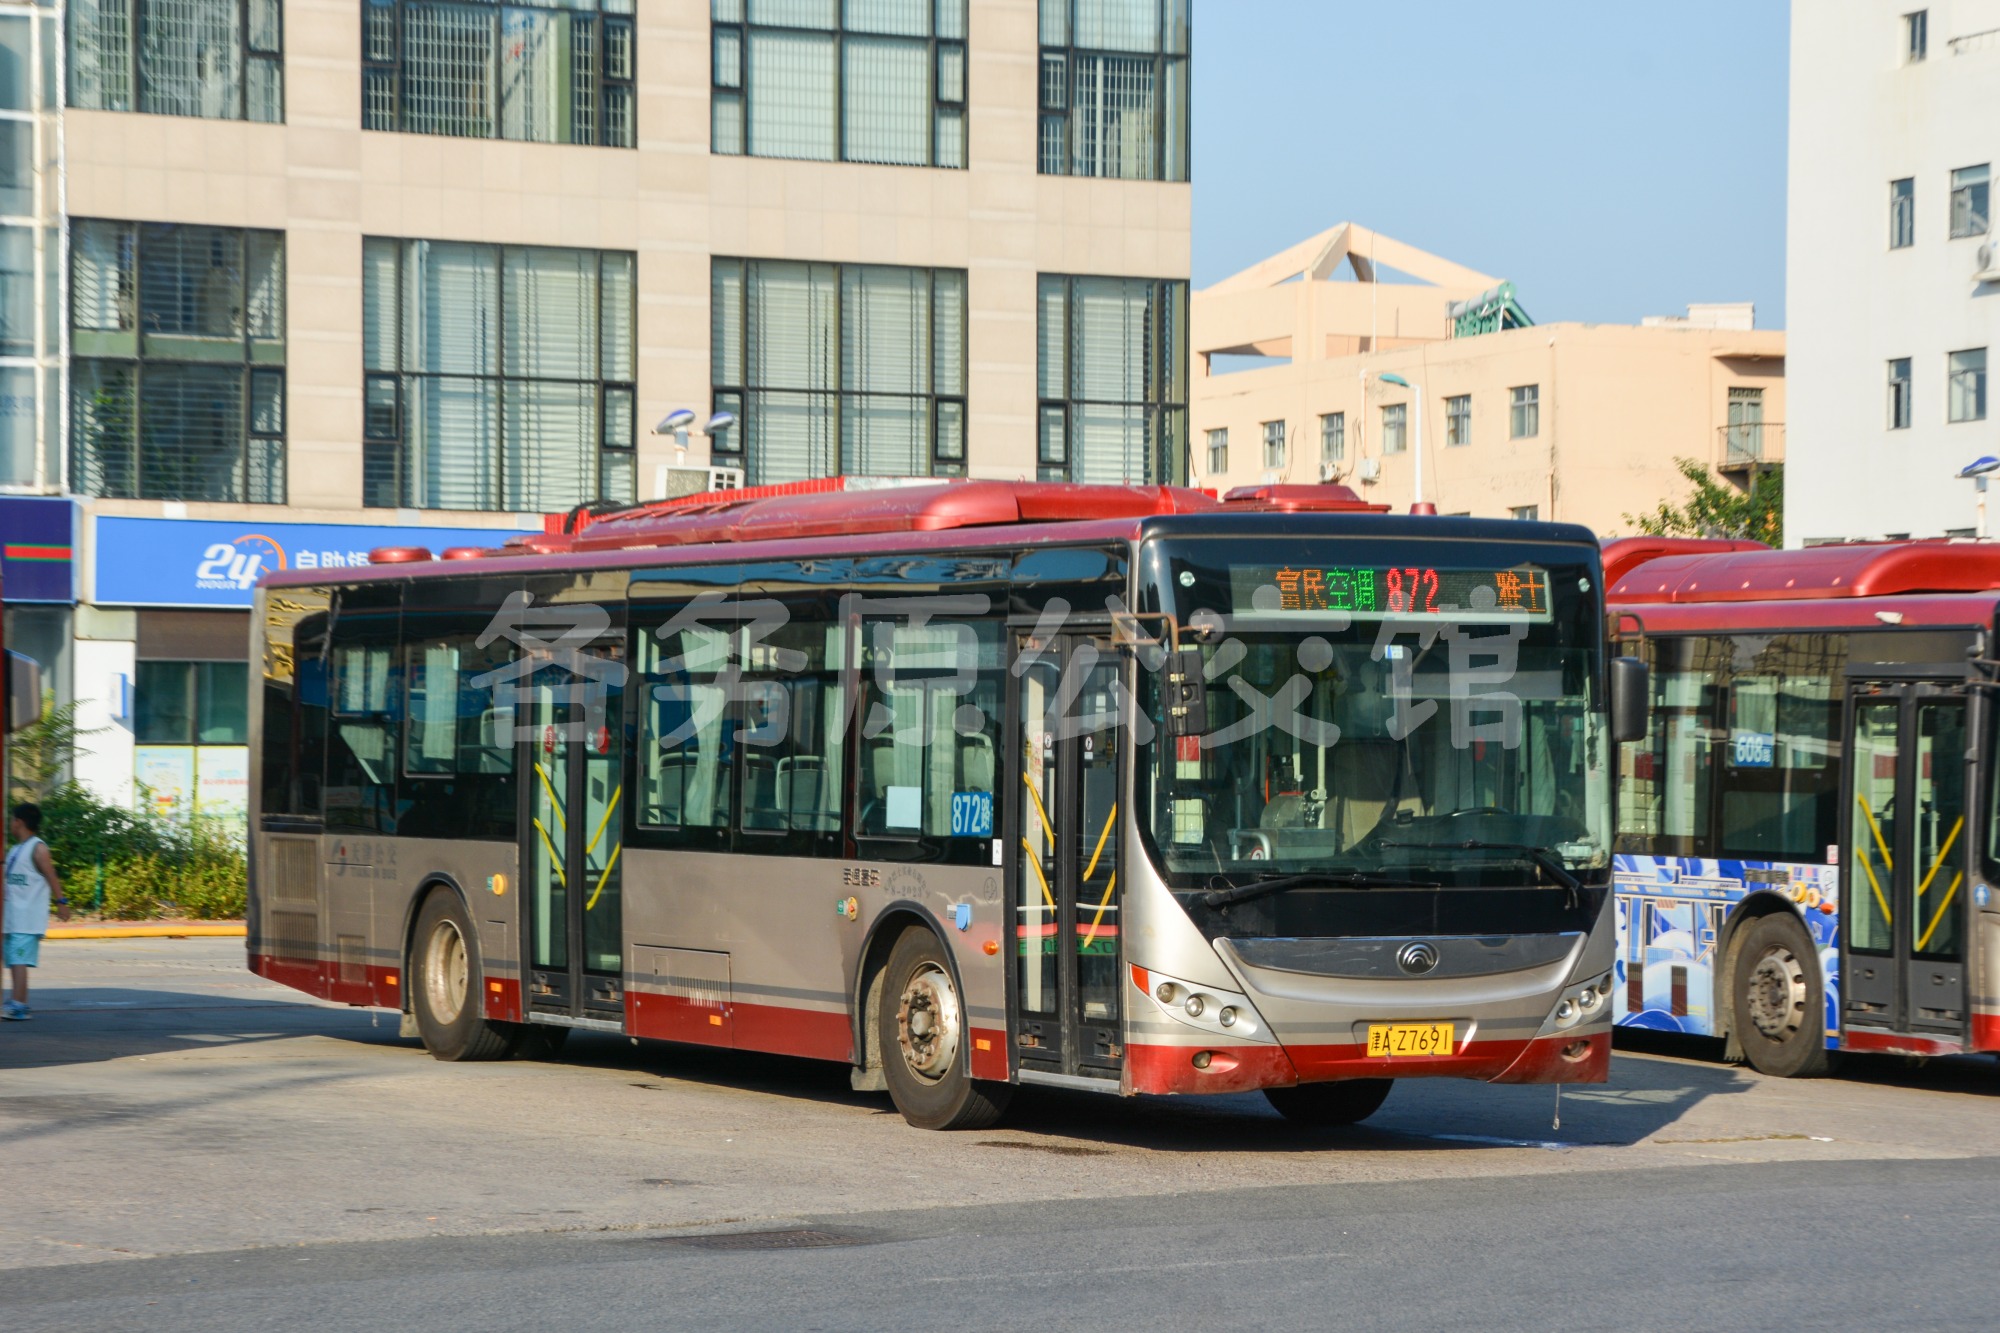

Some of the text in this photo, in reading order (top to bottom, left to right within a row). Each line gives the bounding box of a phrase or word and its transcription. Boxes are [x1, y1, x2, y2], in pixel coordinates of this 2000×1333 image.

[196, 543, 263, 590] 24
[1386, 568, 1440, 613] 872
[952, 794, 991, 834] 872路
